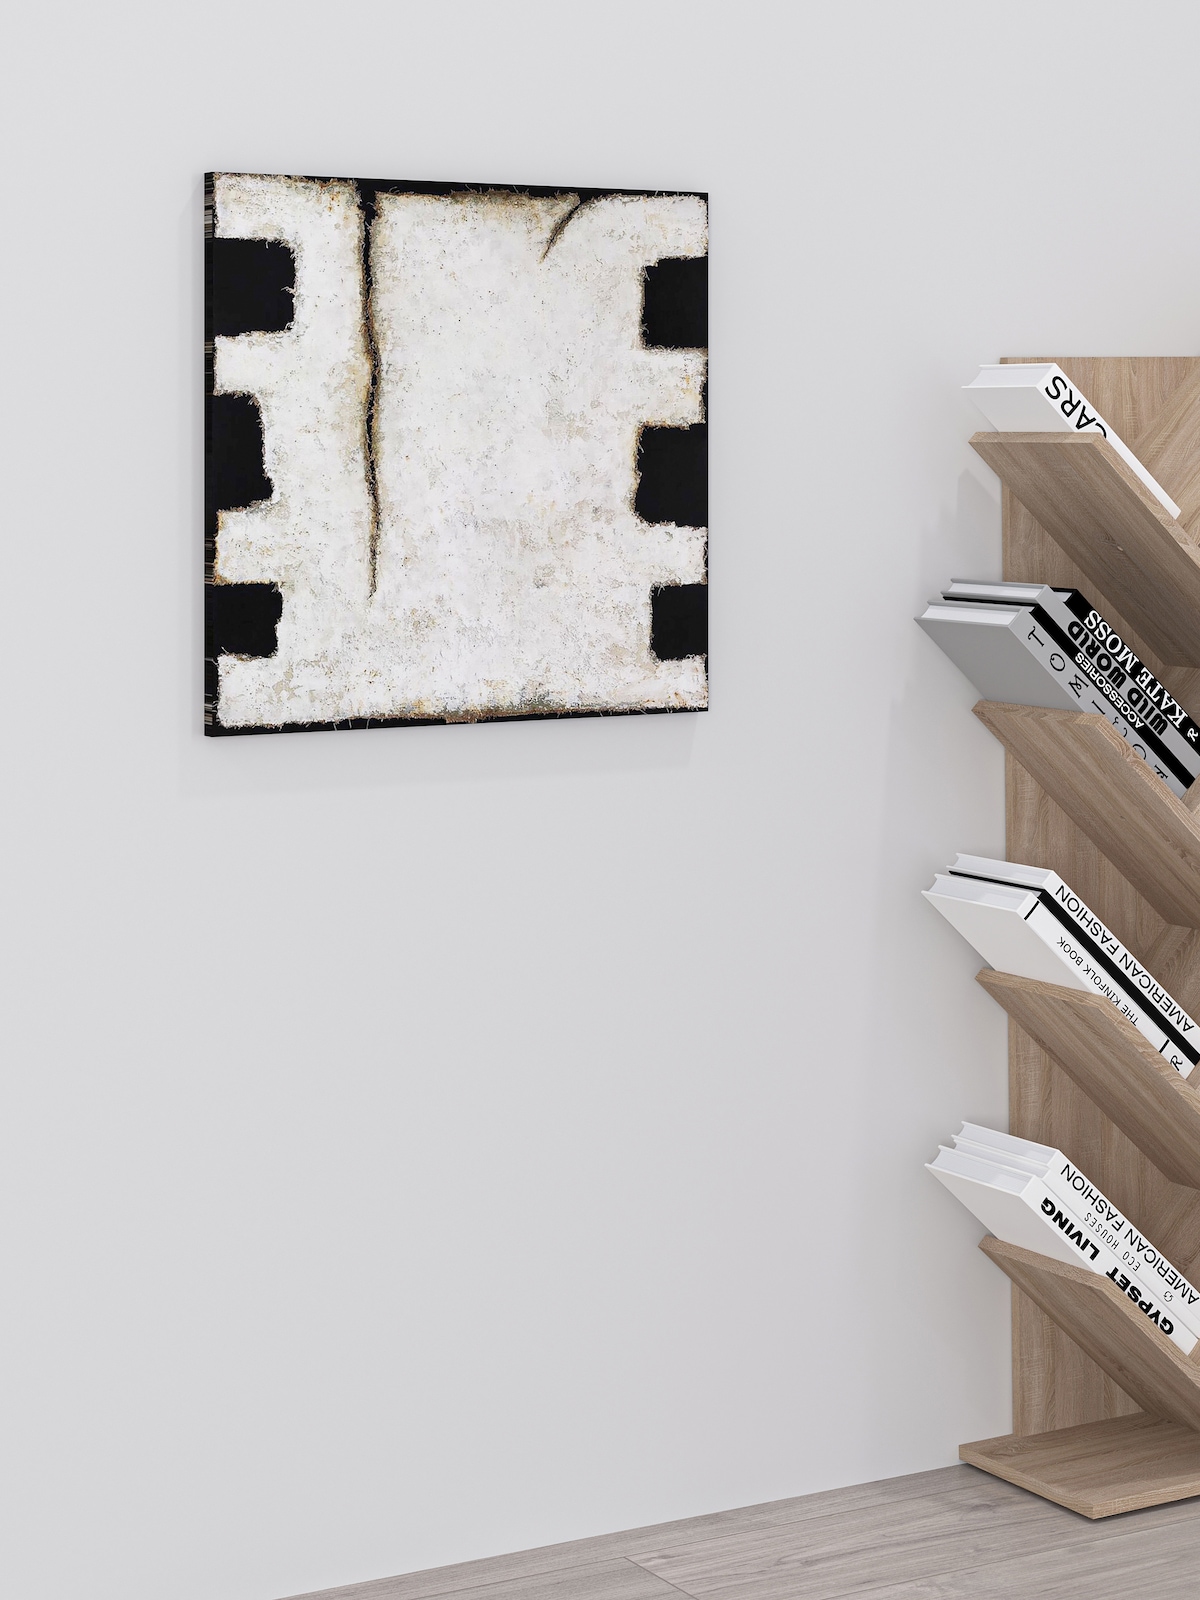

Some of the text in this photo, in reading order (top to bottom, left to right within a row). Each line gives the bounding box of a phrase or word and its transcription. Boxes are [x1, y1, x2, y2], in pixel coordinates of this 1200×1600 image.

[1068, 621, 1168, 736] WILD WORLD
[1075, 652, 1144, 728] ACCESSORIES
[1084, 610, 1189, 729] KATE MOSS
[1055, 884, 1195, 1032] AMERICAN FASHION
[1056, 936, 1139, 1027] THE KINFOLK BOOK
[1040, 1196, 1175, 1335] GYPSET LIVING
[1060, 1163, 1200, 1305] AMERICAN FASHION
[1084, 1212, 1141, 1272] ECO HOUSES
